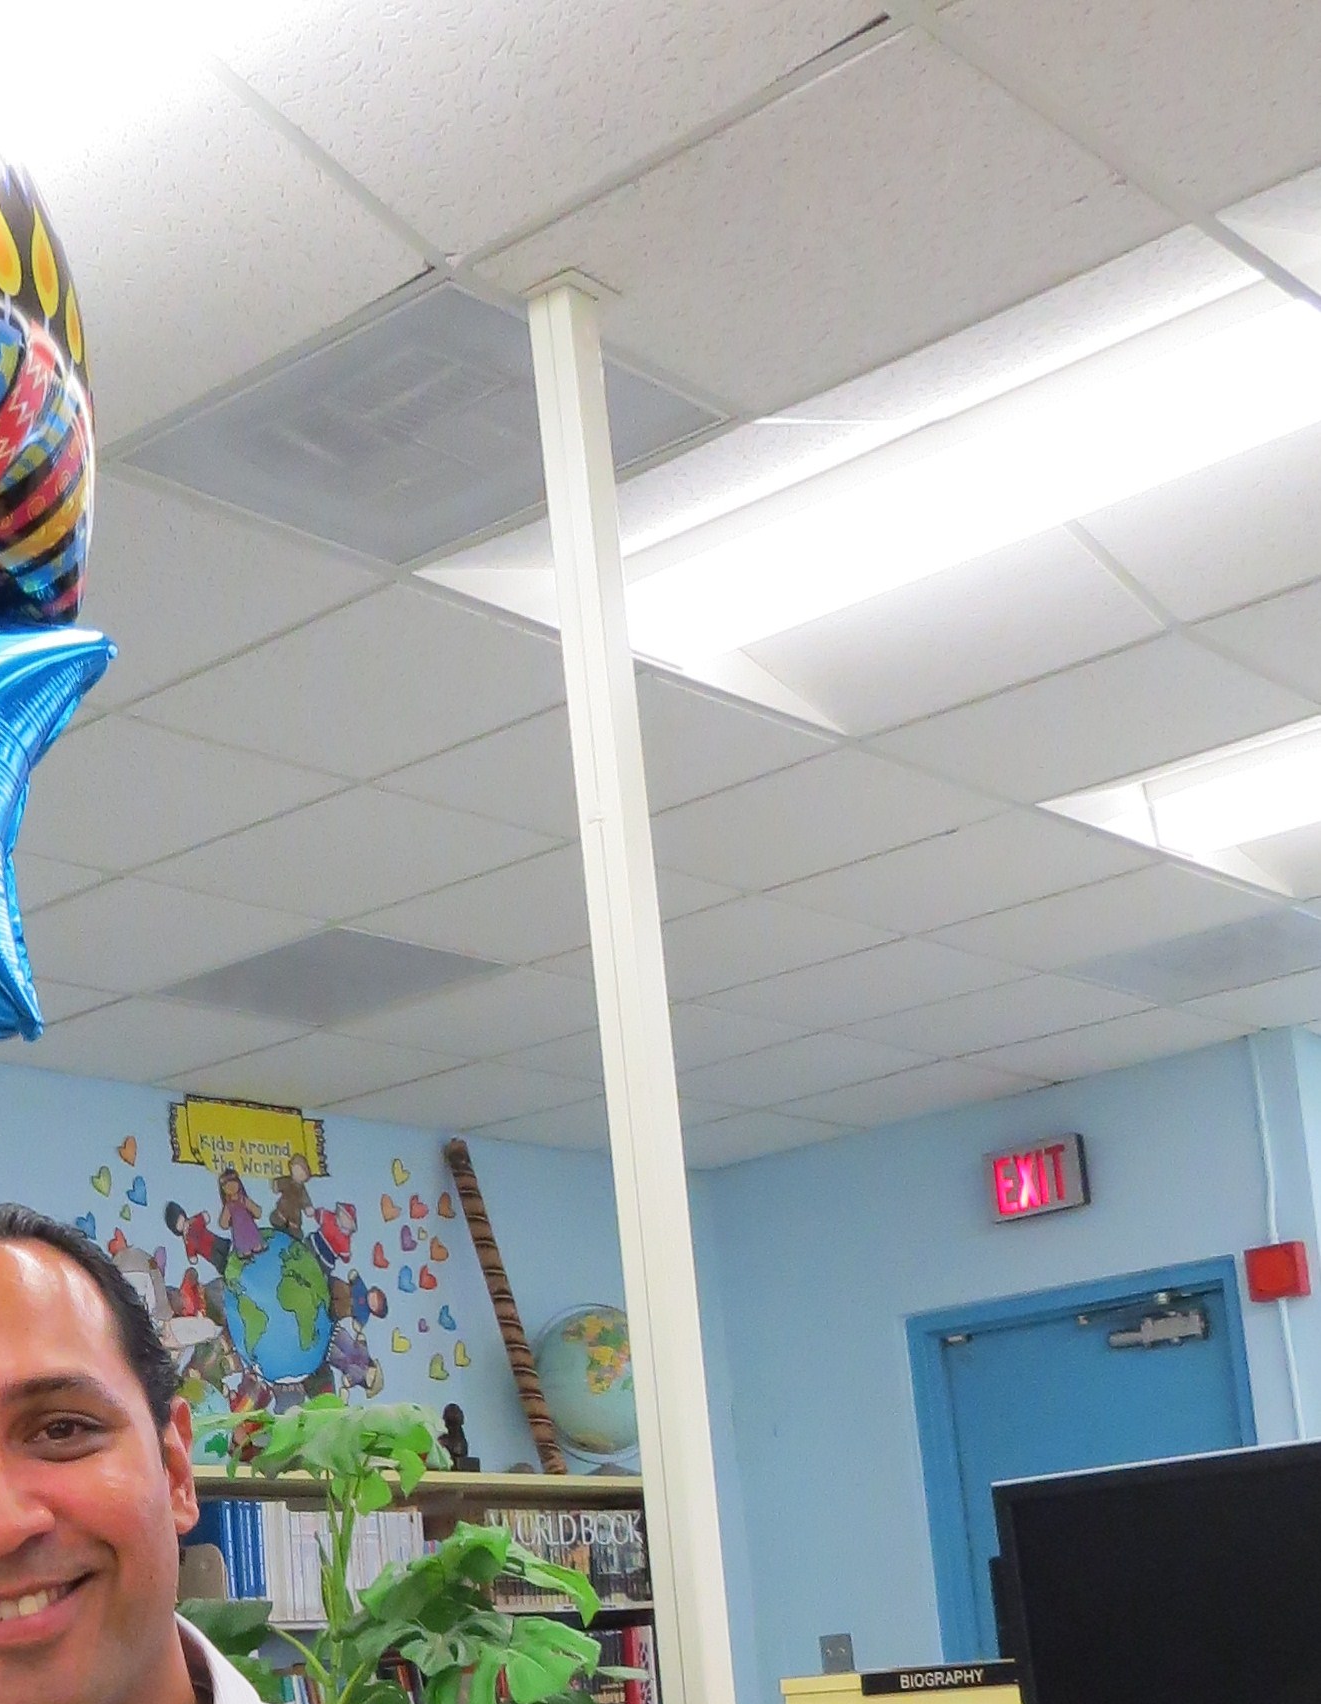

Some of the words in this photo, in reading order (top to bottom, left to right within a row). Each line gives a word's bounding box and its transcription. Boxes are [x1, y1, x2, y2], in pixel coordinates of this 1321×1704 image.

[200, 1134, 235, 1153] Kids
[239, 1139, 291, 1157] Around
[241, 1156, 283, 1175] World
[993, 1143, 1066, 1216] EXIT
[579, 1513, 644, 1546] BOOK
[899, 1668, 985, 1689] BIOGRAPHY
